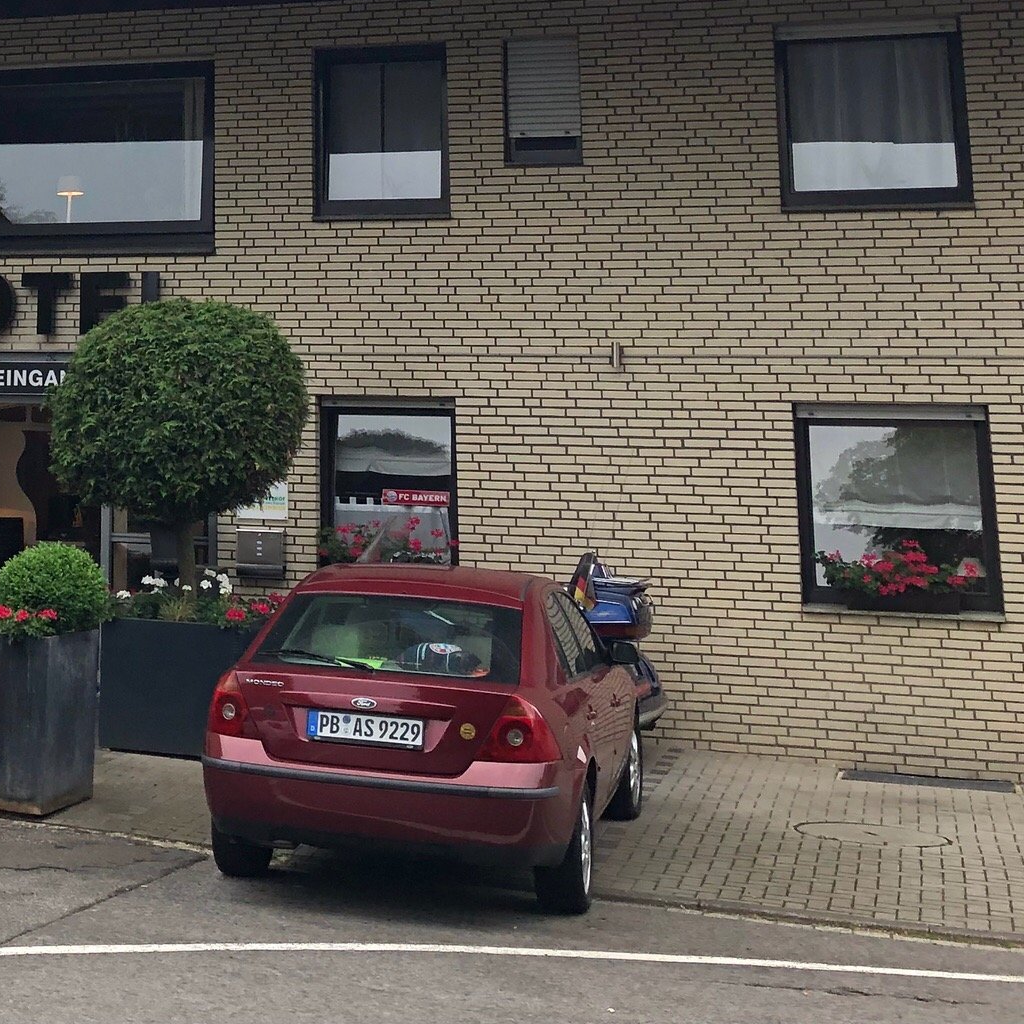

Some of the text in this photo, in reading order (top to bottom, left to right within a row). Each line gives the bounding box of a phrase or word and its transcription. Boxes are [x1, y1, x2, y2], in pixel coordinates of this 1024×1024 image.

[398, 493, 447, 502] FC BAYERN
[245, 678, 285, 687] MONDEO
[319, 714, 340, 734] PB
[352, 717, 375, 737] AS
[378, 720, 421, 743] 9229
